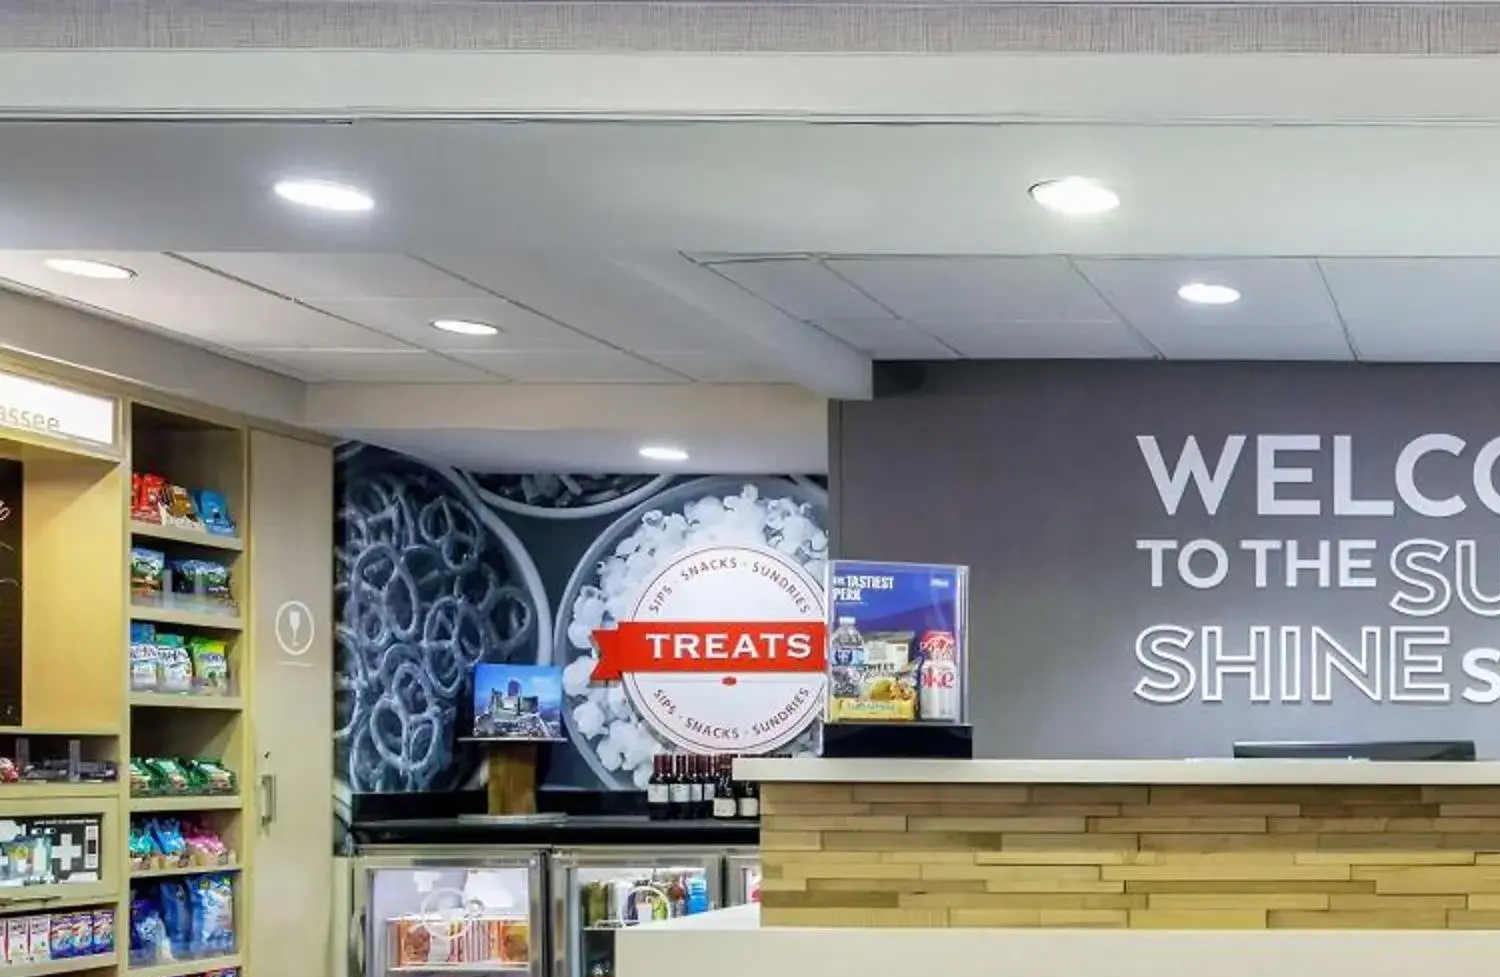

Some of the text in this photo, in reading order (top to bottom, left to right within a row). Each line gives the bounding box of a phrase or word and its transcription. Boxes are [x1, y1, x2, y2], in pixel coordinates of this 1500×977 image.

[649, 557, 811, 614] SIPS SNACKS SUNDRIES
[1136, 539, 1229, 588] TO
[1240, 539, 1377, 588] THE
[645, 633, 812, 660] TREATS
[1133, 624, 1451, 703] SHINE
[653, 687, 809, 739] SIPS SNACKS SUNDRIES
